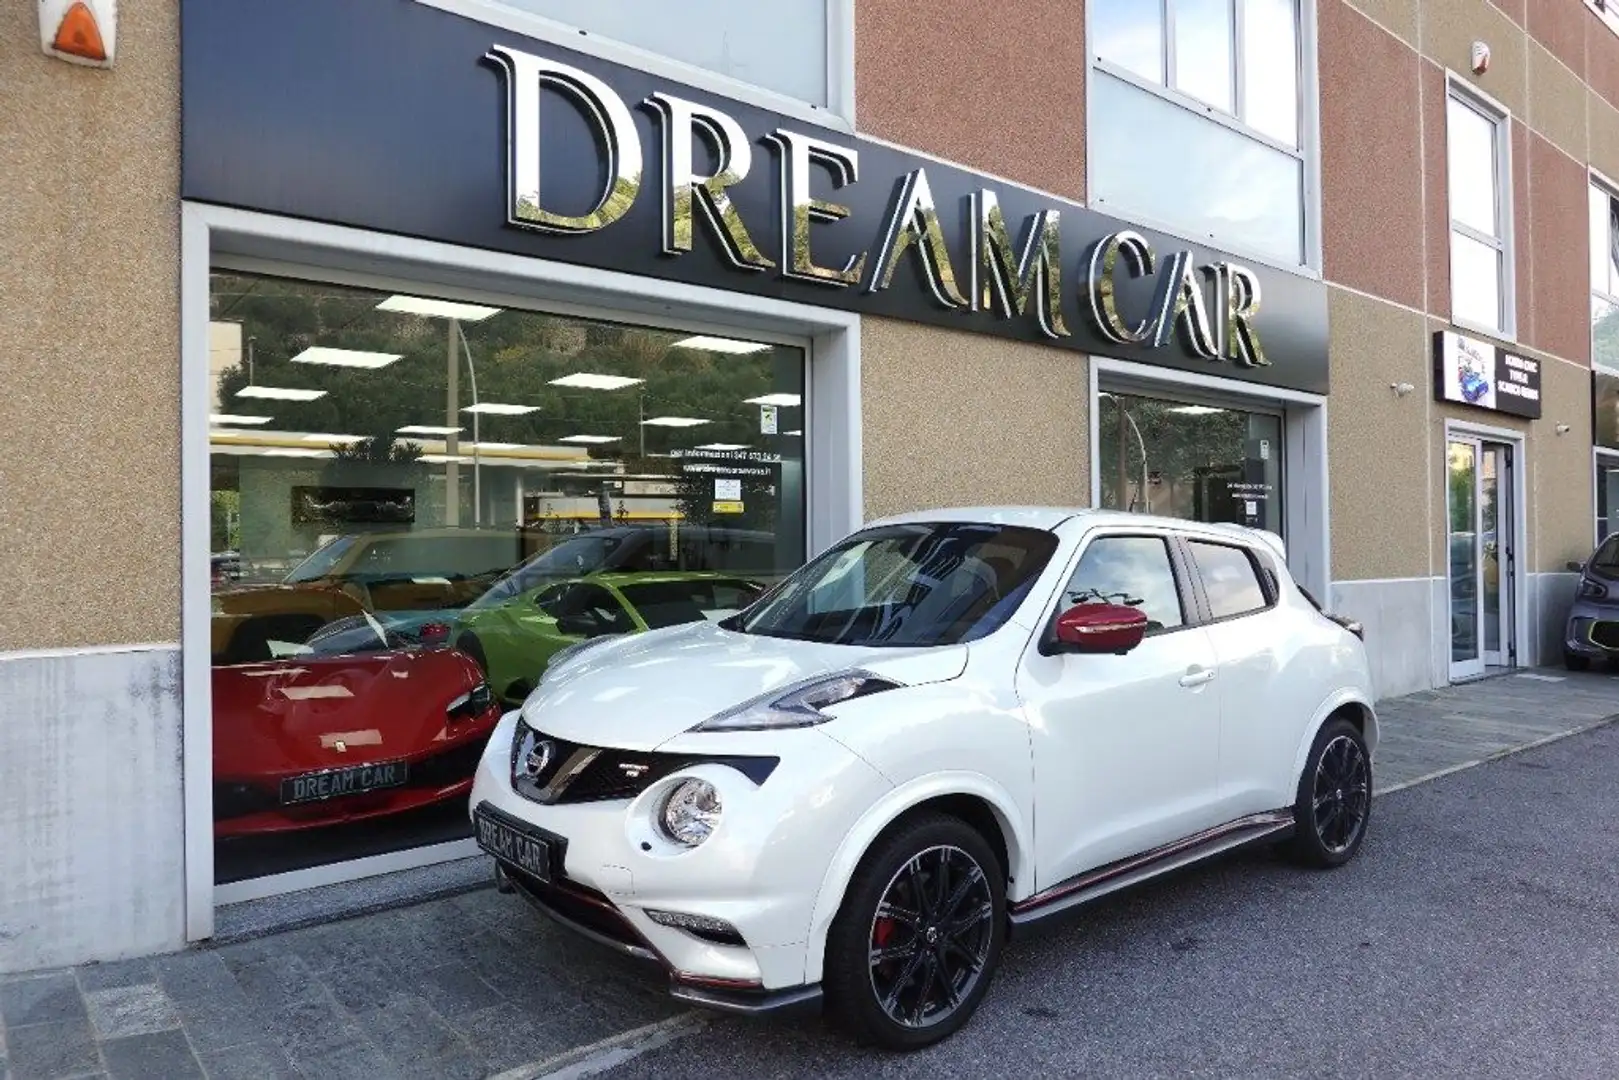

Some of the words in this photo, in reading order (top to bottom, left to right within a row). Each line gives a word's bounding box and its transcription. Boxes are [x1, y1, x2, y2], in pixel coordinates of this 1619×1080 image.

[484, 44, 1071, 339] DREAM
[1089, 231, 1272, 367] CAR
[294, 771, 354, 800] DREAM
[361, 765, 395, 788] CAR
[479, 816, 514, 860] DREAM
[516, 836, 541, 875] CAR
